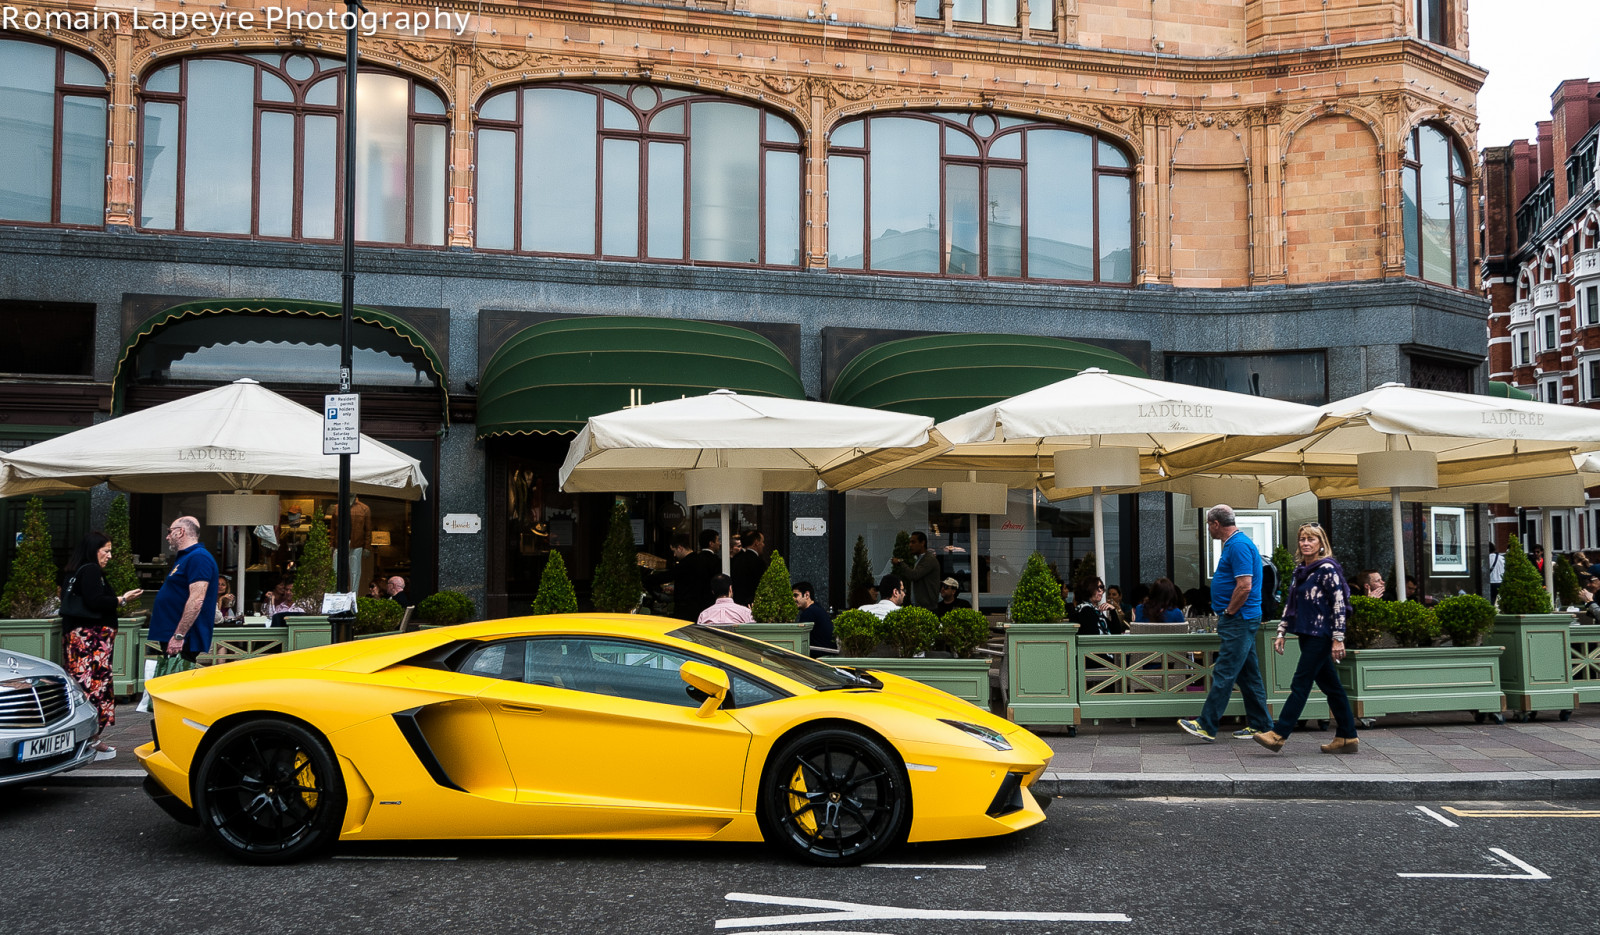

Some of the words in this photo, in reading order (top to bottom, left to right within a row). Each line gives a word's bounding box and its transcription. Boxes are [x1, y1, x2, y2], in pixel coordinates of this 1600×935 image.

[329, 409, 336, 419] P
[1138, 403, 1213, 418] LADURÉE
[1481, 411, 1545, 425] LADURÉE
[1168, 421, 1189, 431] Paris
[30, 738, 52, 756] KM11
[54, 732, 70, 751] EPV
